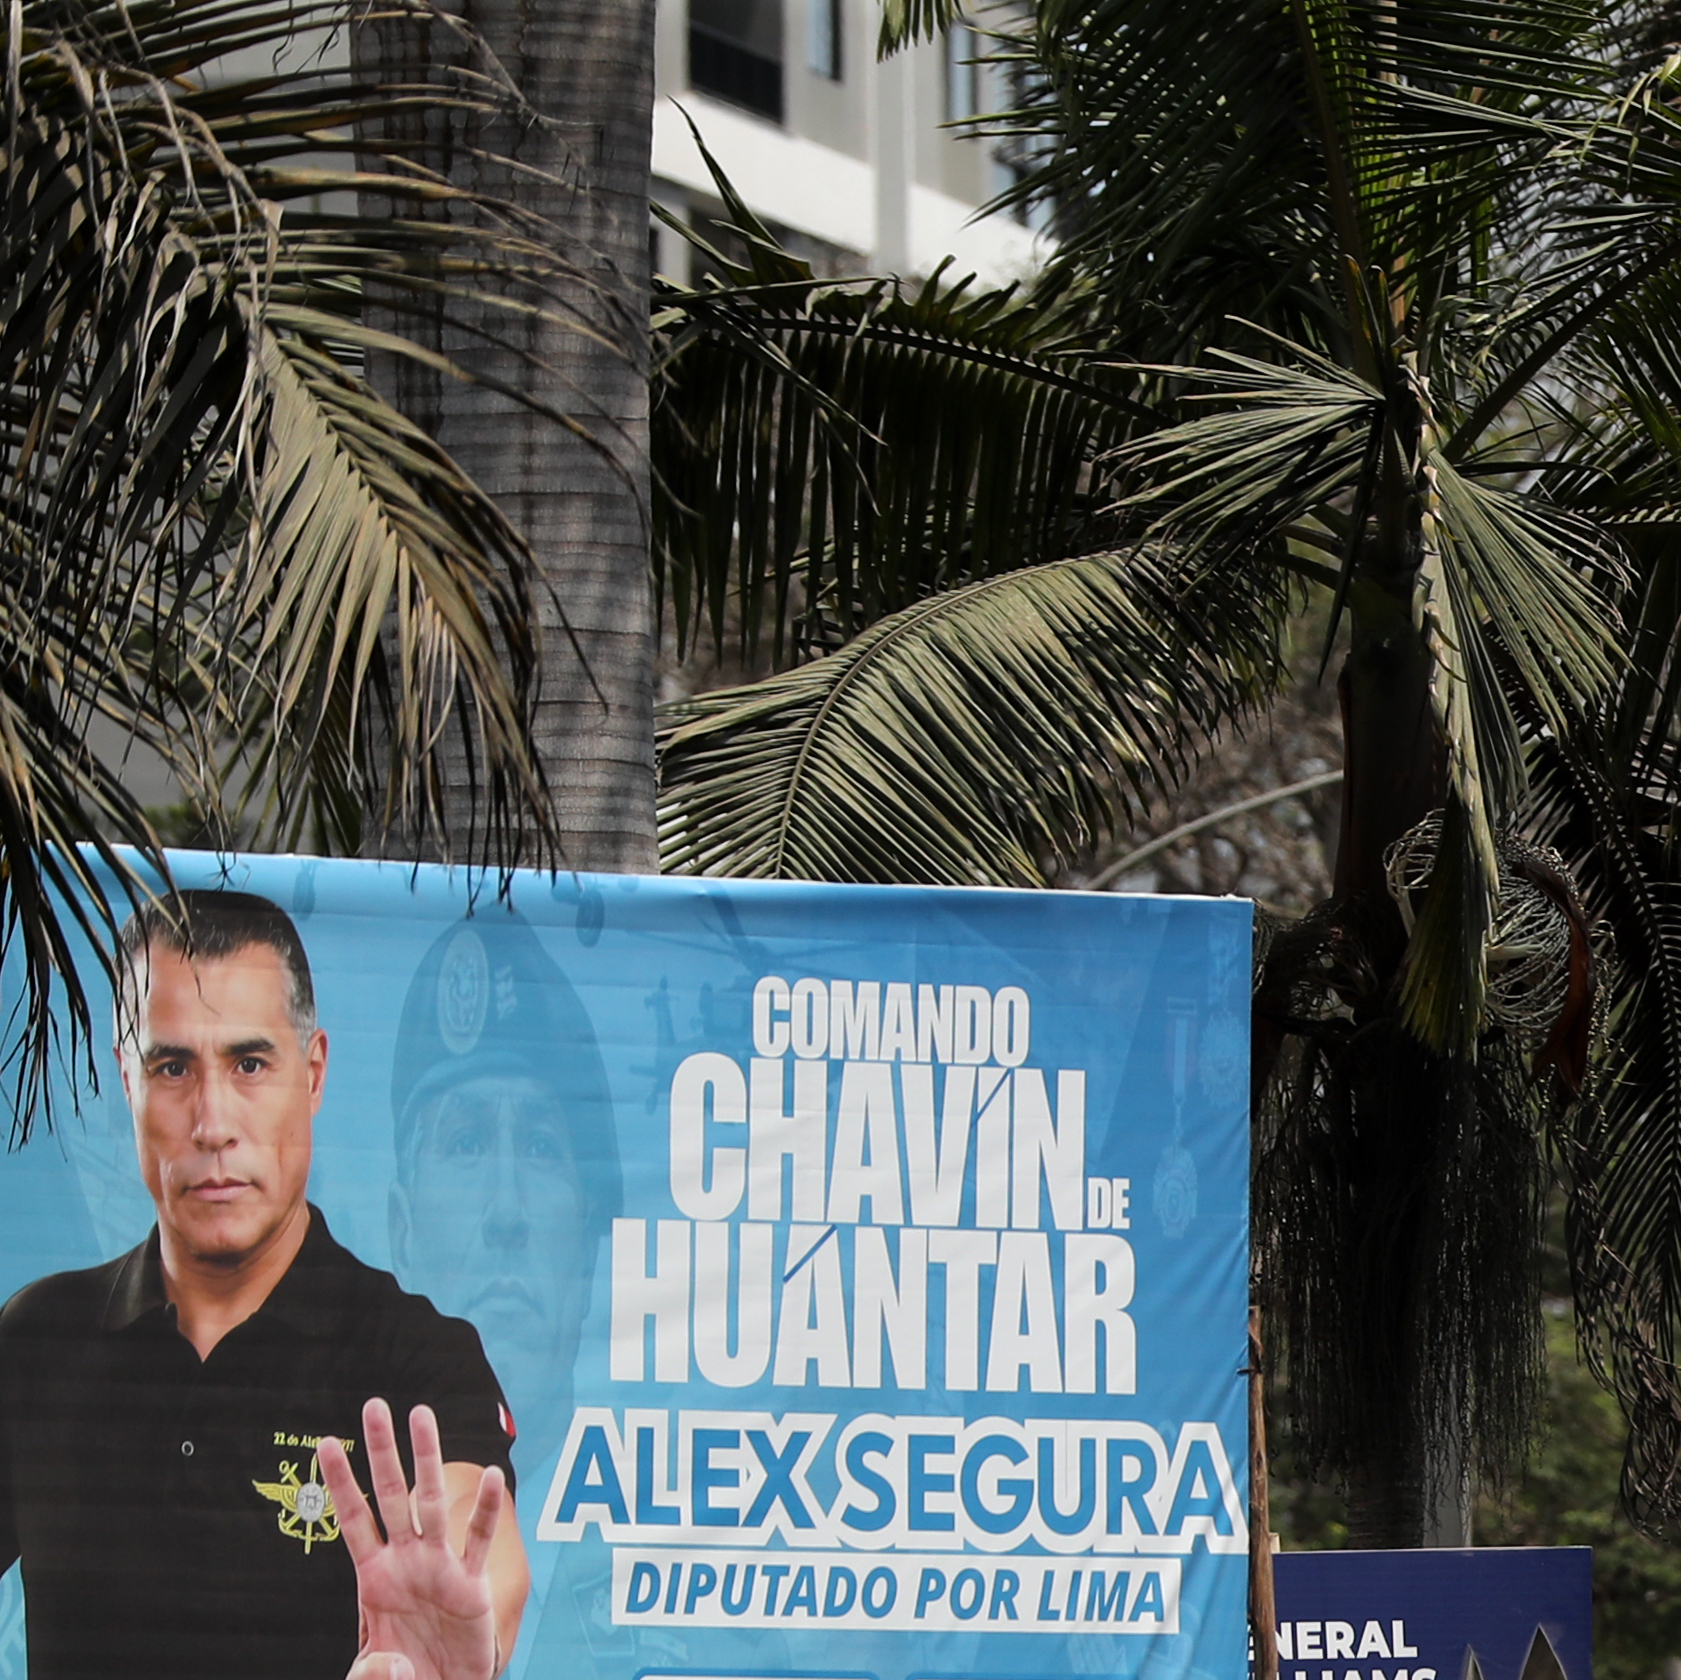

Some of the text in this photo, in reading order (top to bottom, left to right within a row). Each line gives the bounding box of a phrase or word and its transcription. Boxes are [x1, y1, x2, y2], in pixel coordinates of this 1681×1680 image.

[752, 975, 1031, 1068] COMANDO
[1087, 1177, 1131, 1231] DE
[550, 1418, 1242, 1544] ALEX SEGURA
[627, 1563, 1165, 1622] DIPUTADO POR LIMA
